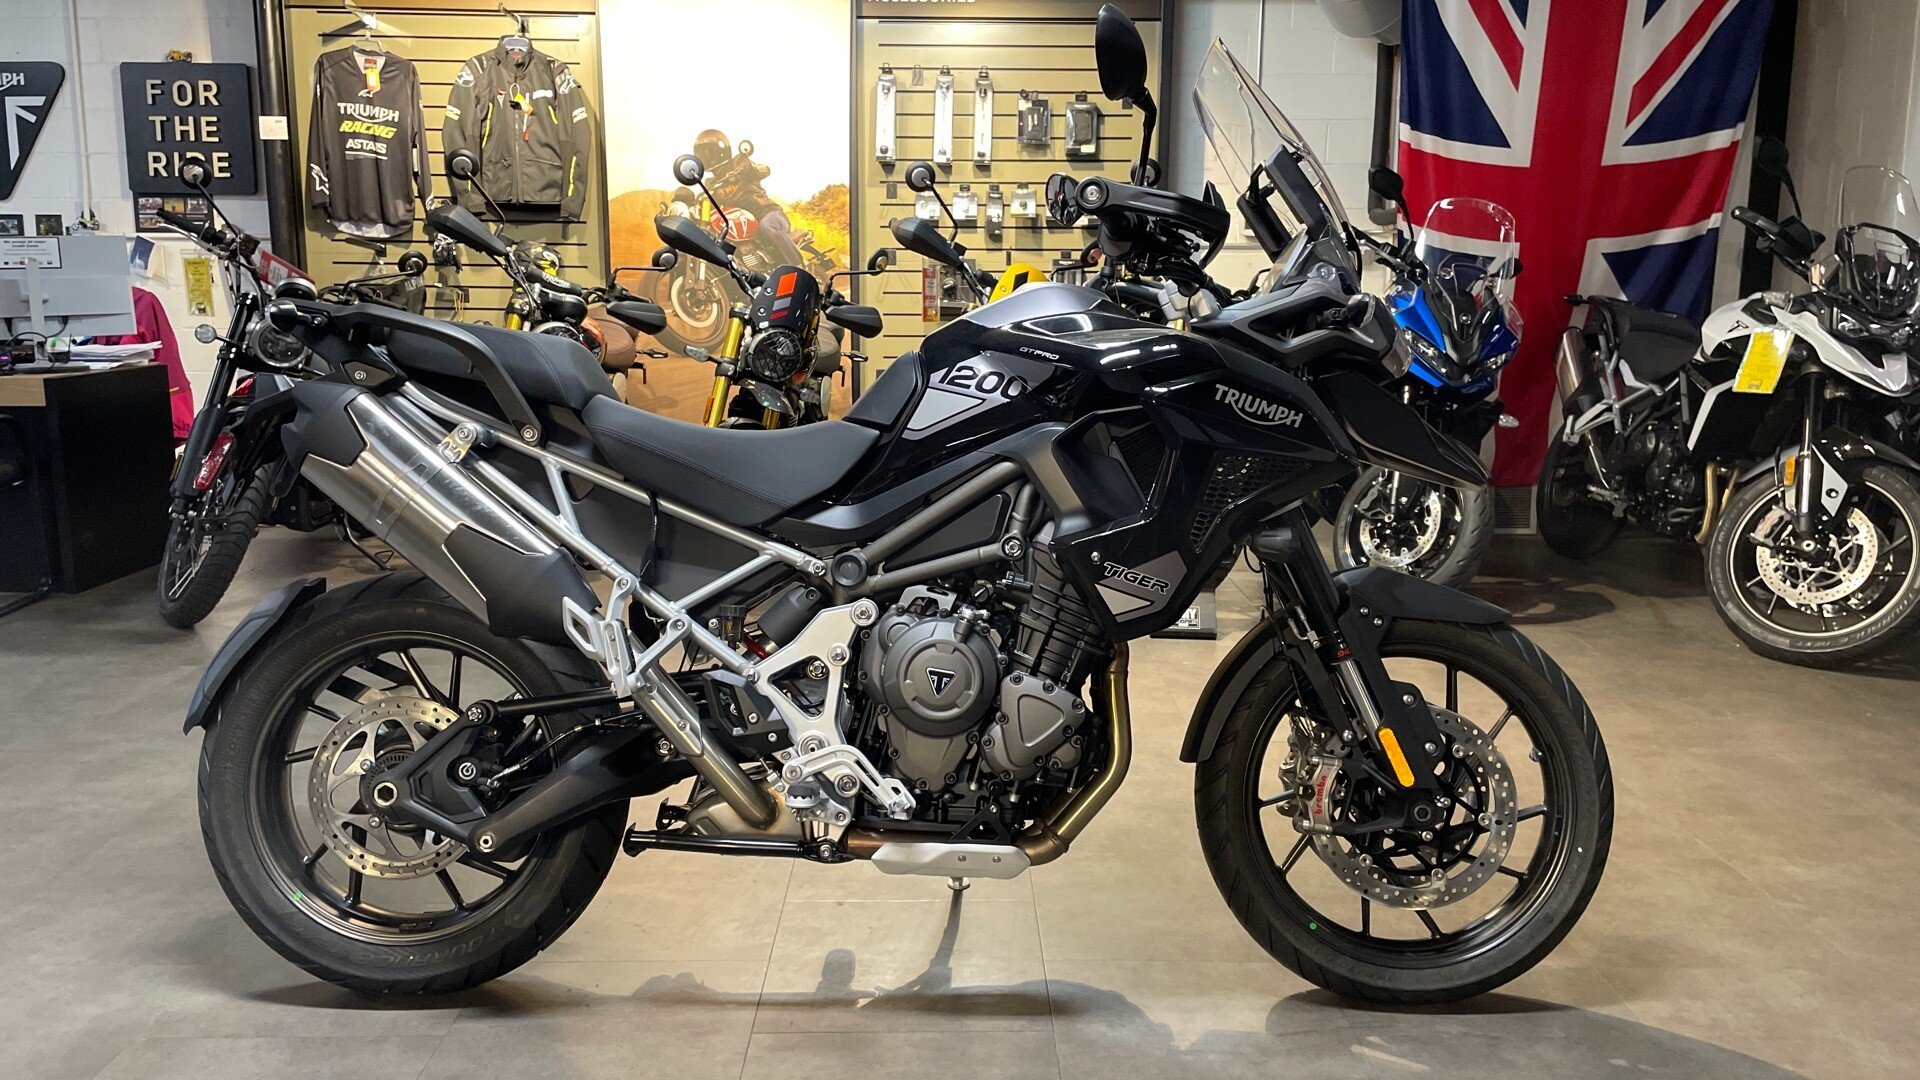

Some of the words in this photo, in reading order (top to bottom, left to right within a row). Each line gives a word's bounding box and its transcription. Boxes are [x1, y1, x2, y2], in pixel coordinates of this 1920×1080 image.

[0, 72, 25, 90] PH
[145, 79, 220, 107] FOR
[337, 102, 400, 123] TRIUMPH
[148, 115, 220, 142] THE
[339, 120, 398, 139] RACNG
[938, 364, 1028, 399] 1200
[1215, 383, 1304, 428] TRIUMPH
[1103, 561, 1171, 595] TIGER
[1314, 775, 1328, 815] brembo
